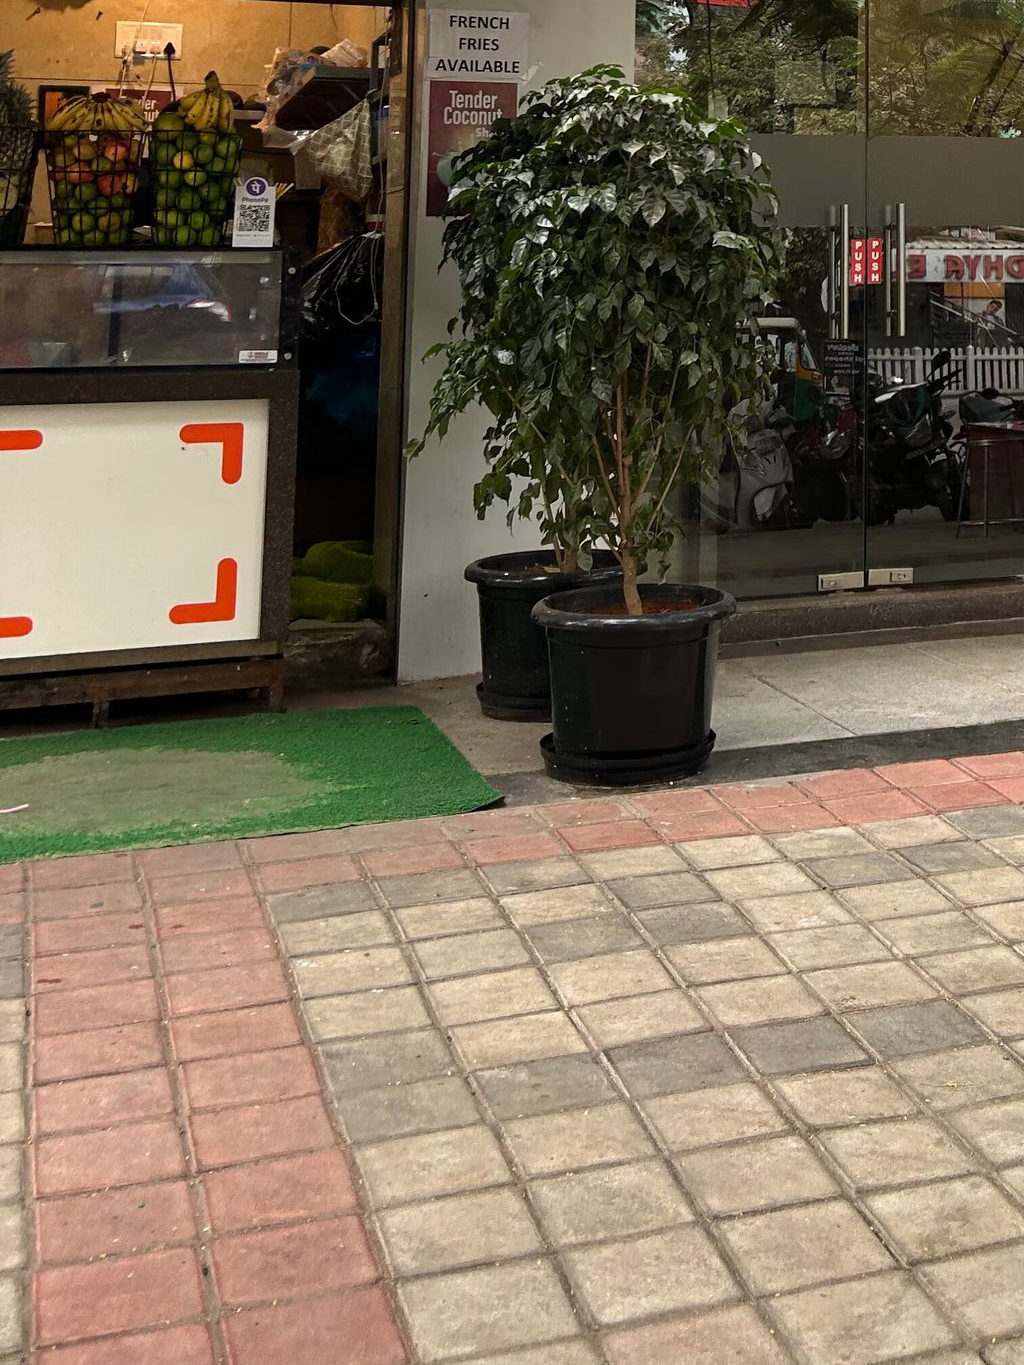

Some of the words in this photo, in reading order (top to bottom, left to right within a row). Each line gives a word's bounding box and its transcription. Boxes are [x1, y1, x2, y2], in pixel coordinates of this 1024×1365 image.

[449, 15, 510, 29] FRENCH
[459, 37, 500, 51] FRIES
[435, 58, 521, 74] AVAILABLE
[448, 90, 498, 109] Tender
[855, 241, 864, 284] PUSH
[871, 240, 880, 283] PUSH
